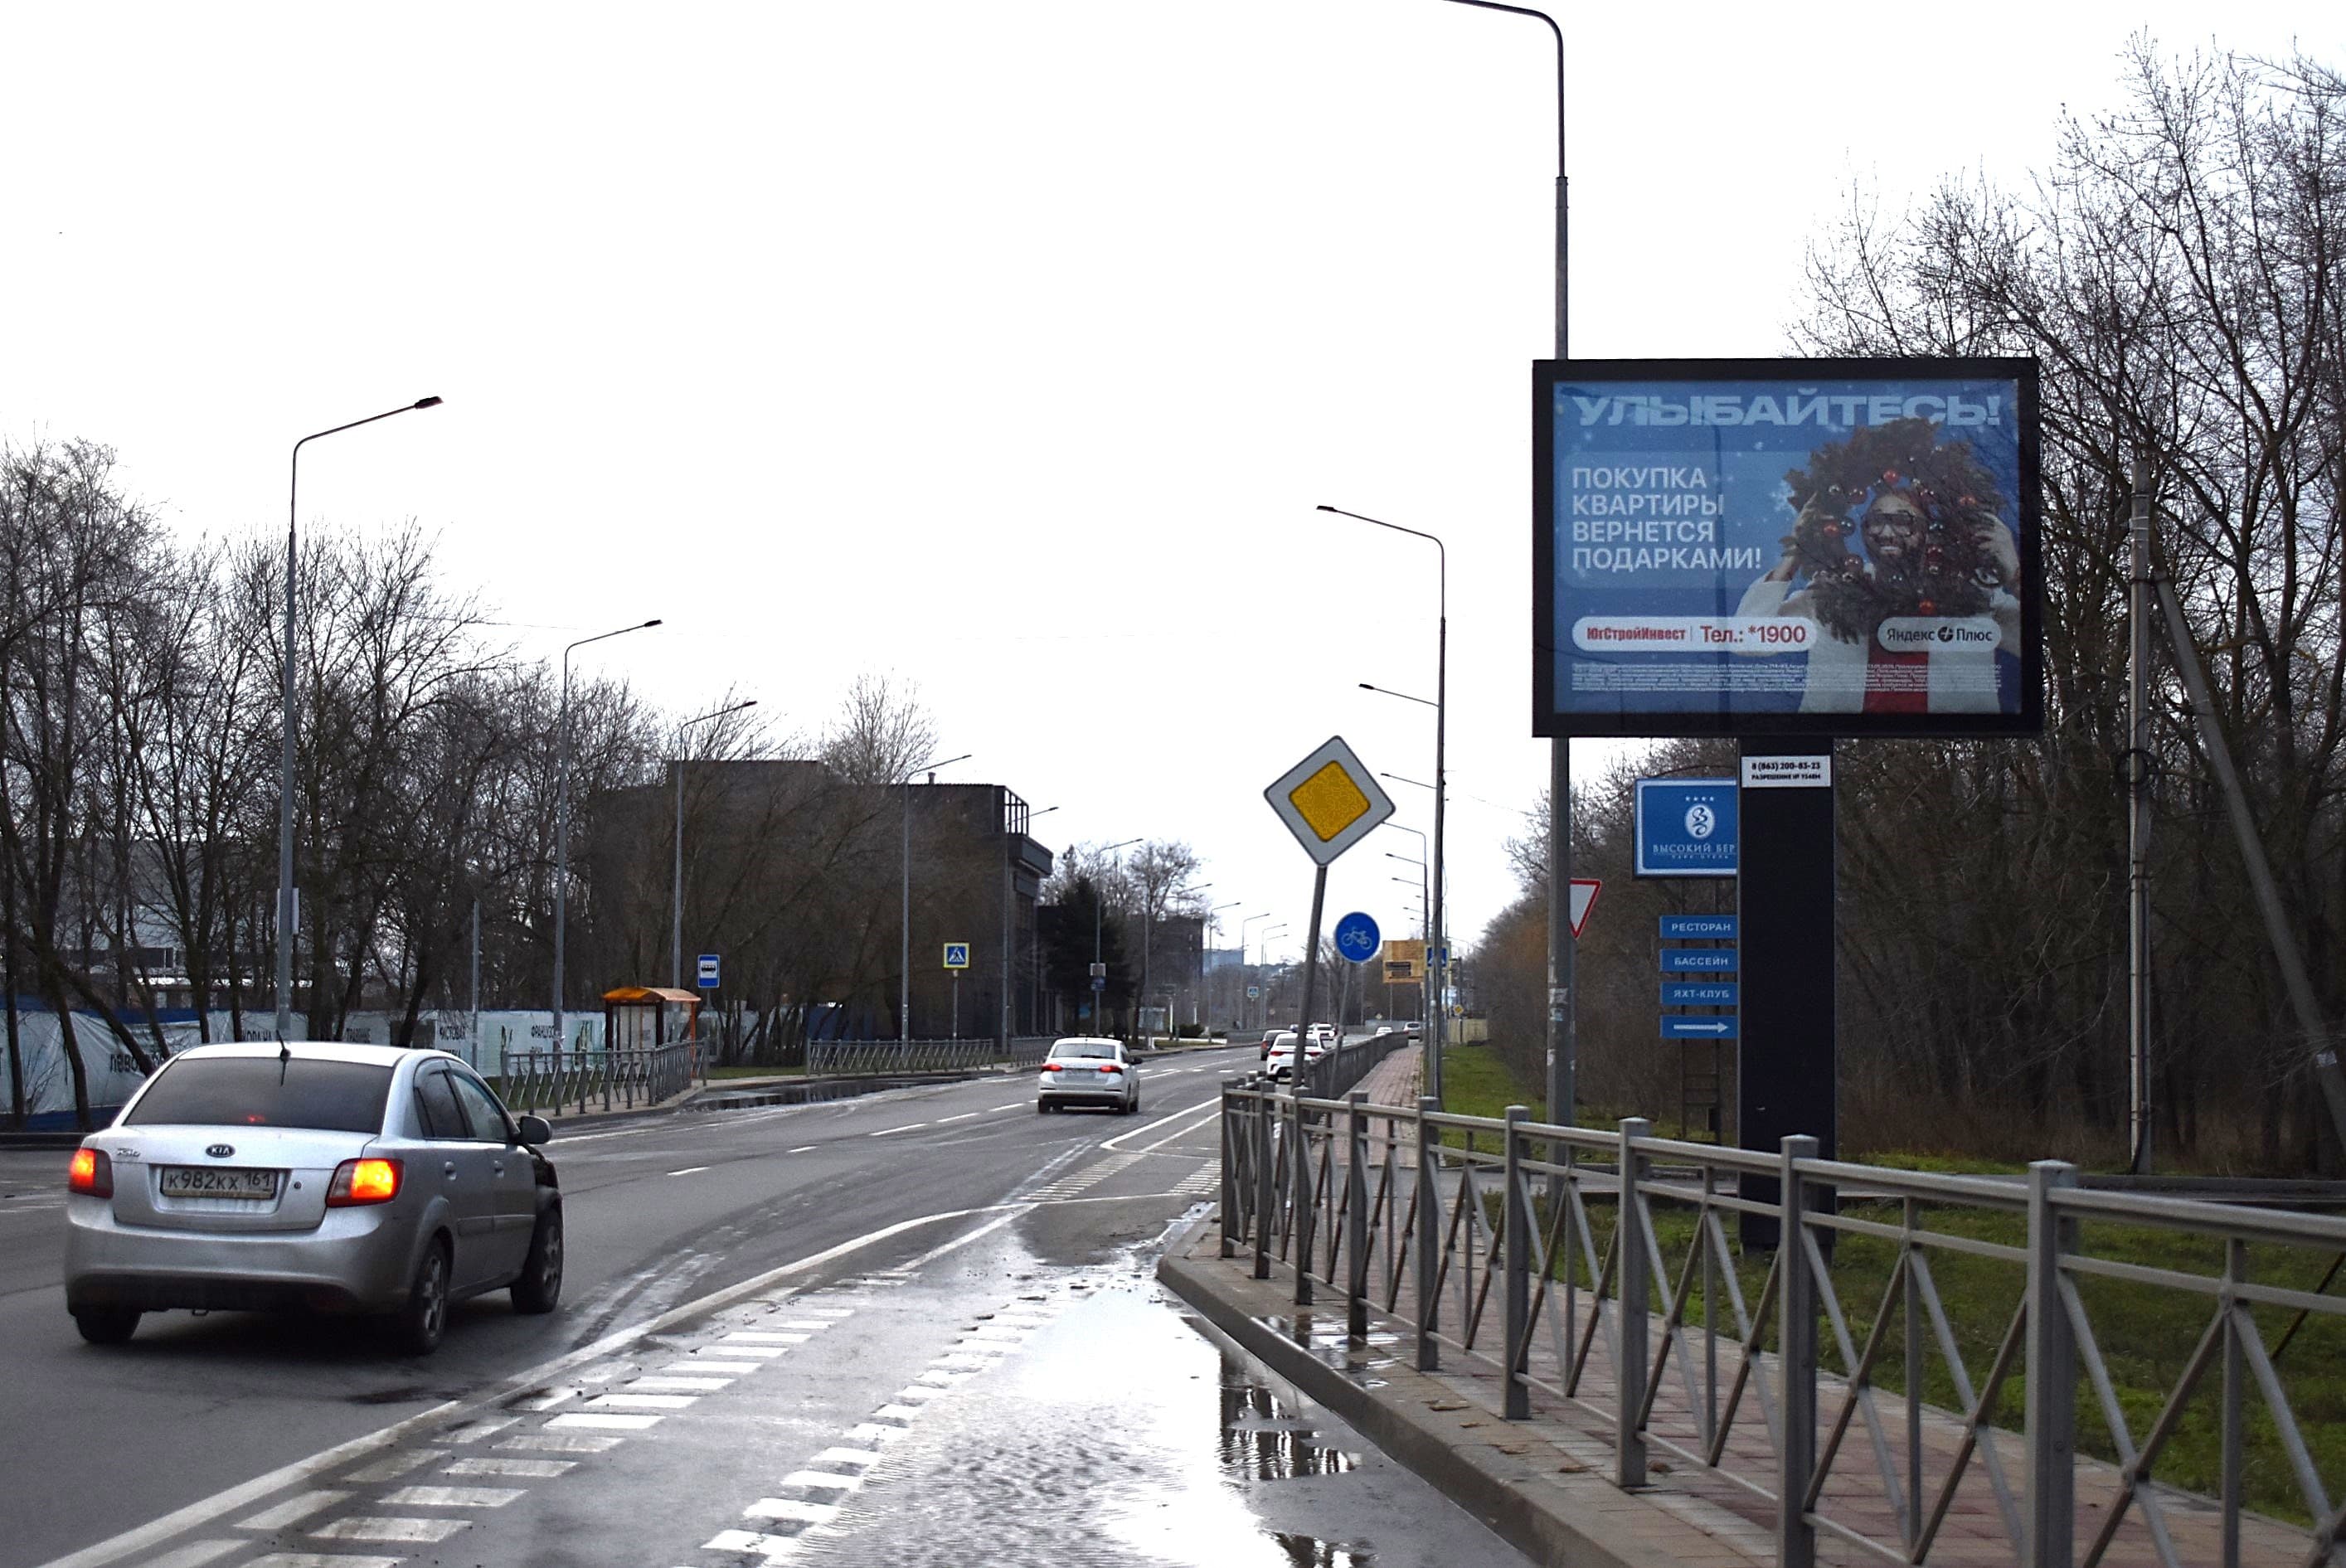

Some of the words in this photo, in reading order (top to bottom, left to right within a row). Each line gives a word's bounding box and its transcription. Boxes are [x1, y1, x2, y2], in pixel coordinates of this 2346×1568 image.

[1571, 387, 2000, 425] УЛЫБАЙТЕСЬ!
[1572, 468, 1707, 489] ПОКУПКА
[1572, 494, 1724, 516] КВАРТИРЫ
[1572, 521, 1714, 543] ВЕРНЕТСЯ
[1572, 547, 1761, 573] ПОДАРКАМИ!
[1586, 626, 1686, 642] ЮгСтройИнвест
[1700, 625, 1744, 643] Тел.:
[1887, 628, 1935, 643] Яндекс
[1956, 628, 1993, 642] Плюс
[1653, 842, 1712, 853] ВЫСОКИЙ
[1716, 843, 1736, 853] БЕР
[1671, 922, 1732, 932] РЕСТОРАН
[1673, 955, 1729, 966] БАССЕЙН
[1673, 988, 1730, 998] ЯХТ-КЛУБ
[210, 1146, 231, 1155] KIA
[244, 1172, 270, 1187] 161
